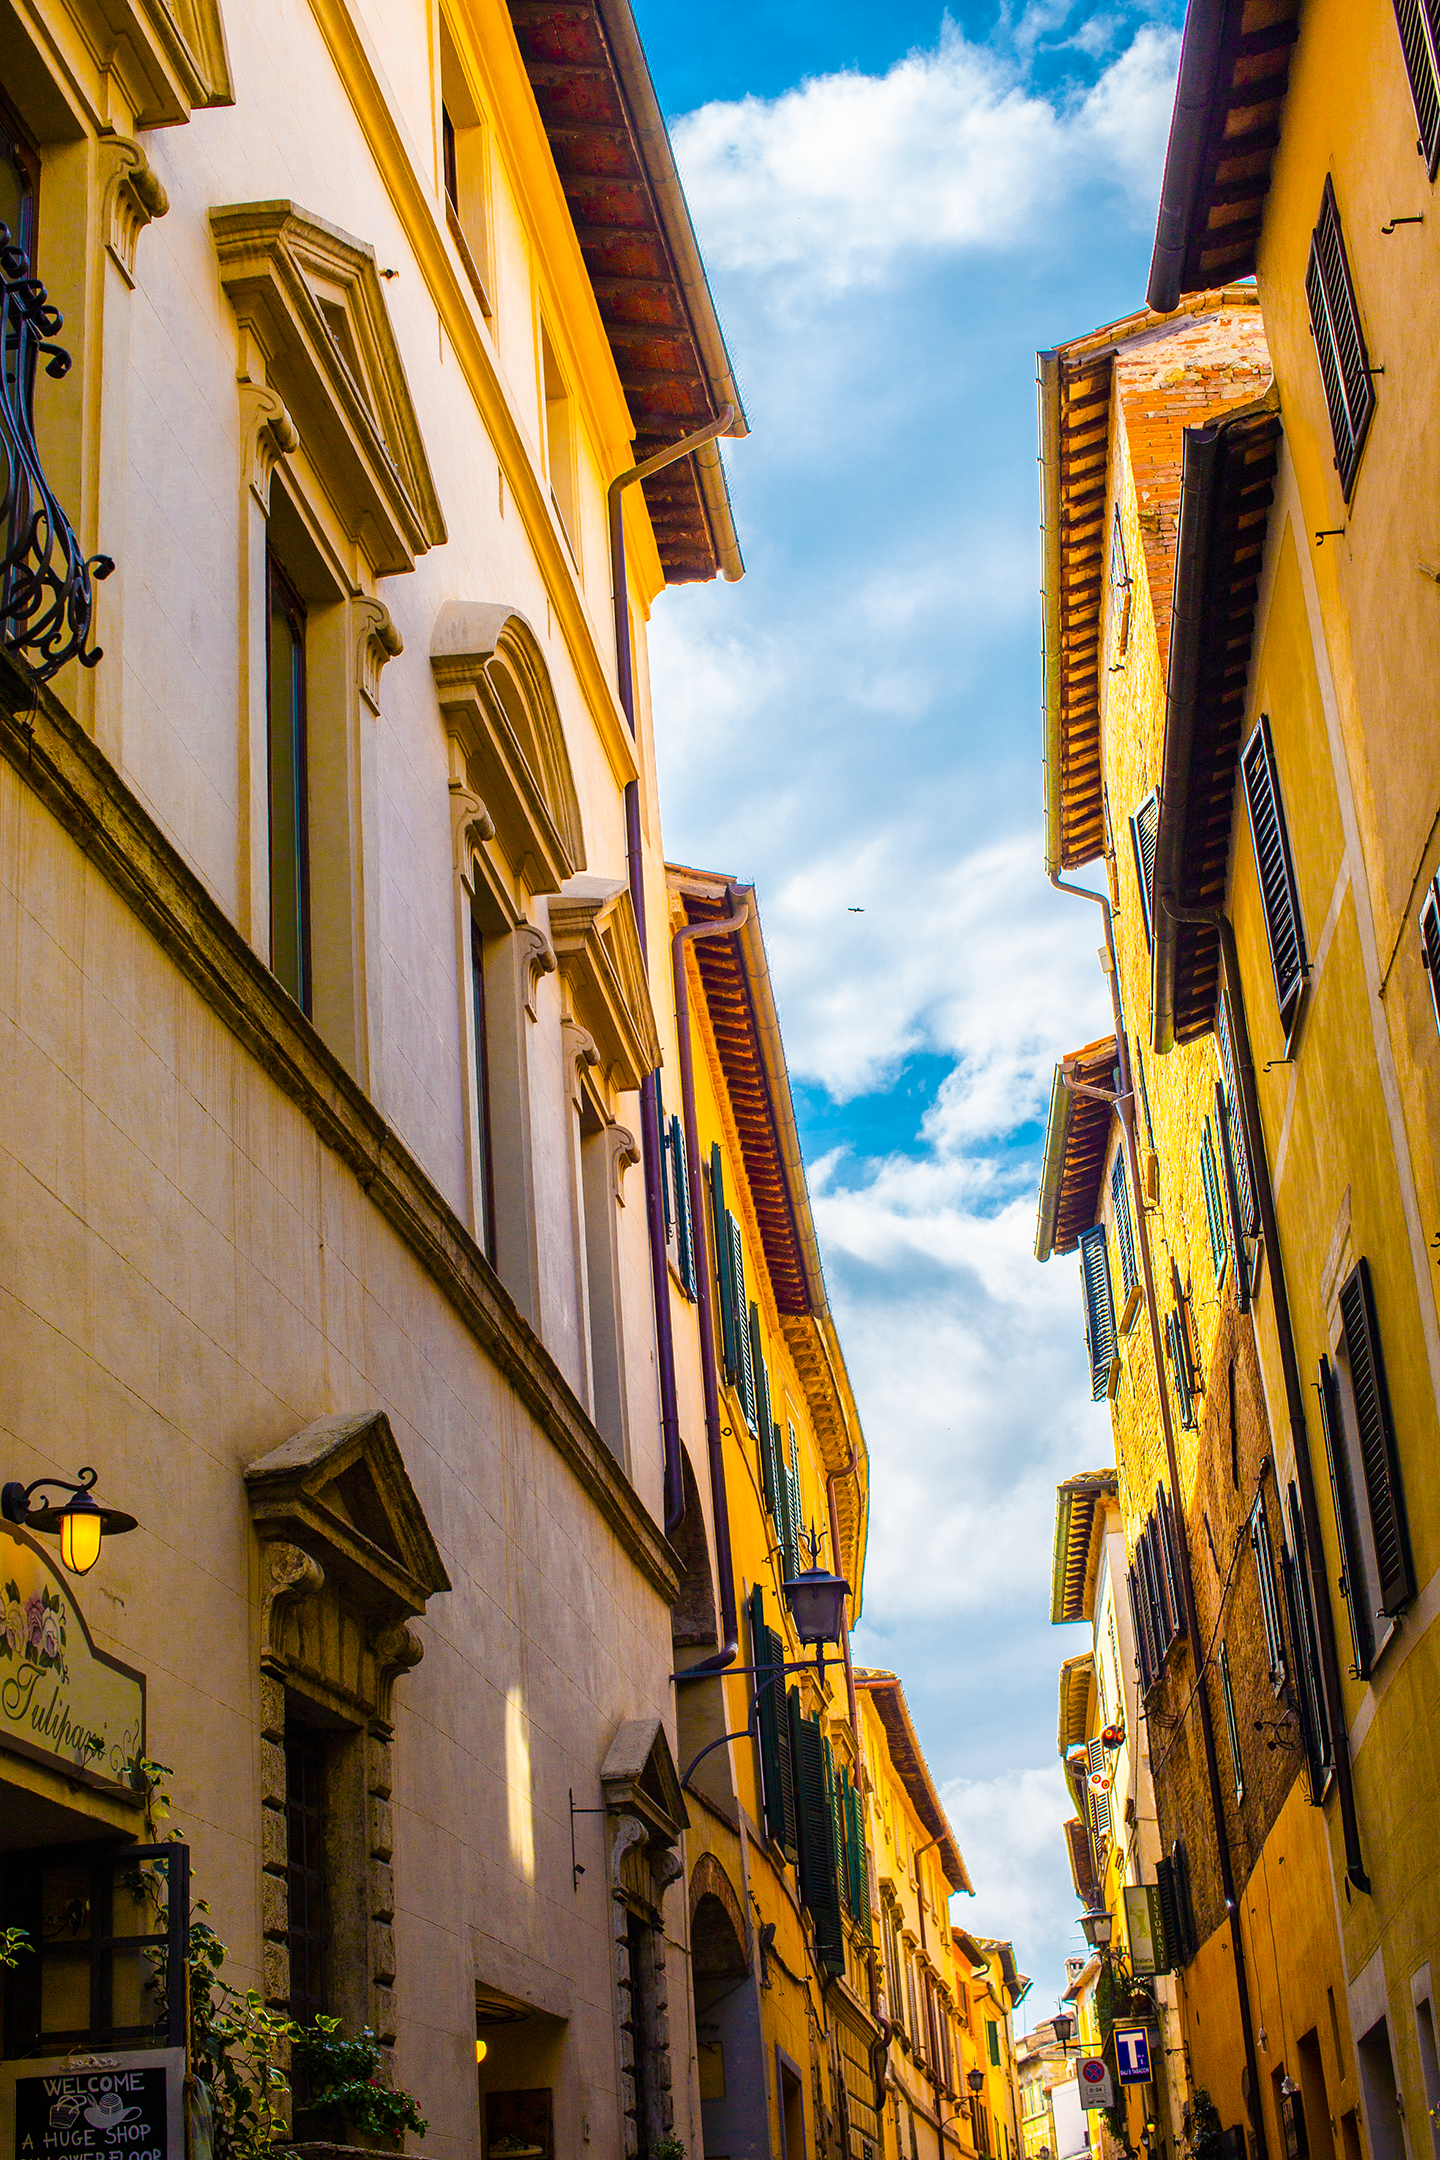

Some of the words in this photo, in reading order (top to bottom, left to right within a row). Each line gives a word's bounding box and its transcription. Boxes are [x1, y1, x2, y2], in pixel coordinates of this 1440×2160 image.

[1151, 1886, 1166, 1969] RISTORANTE
[1118, 2032, 1144, 2069] T
[43, 2073, 145, 2097] WELCOME
[21, 2133, 34, 2150] A
[43, 2129, 96, 2149] HUGE
[104, 2124, 151, 2144] SHOP
